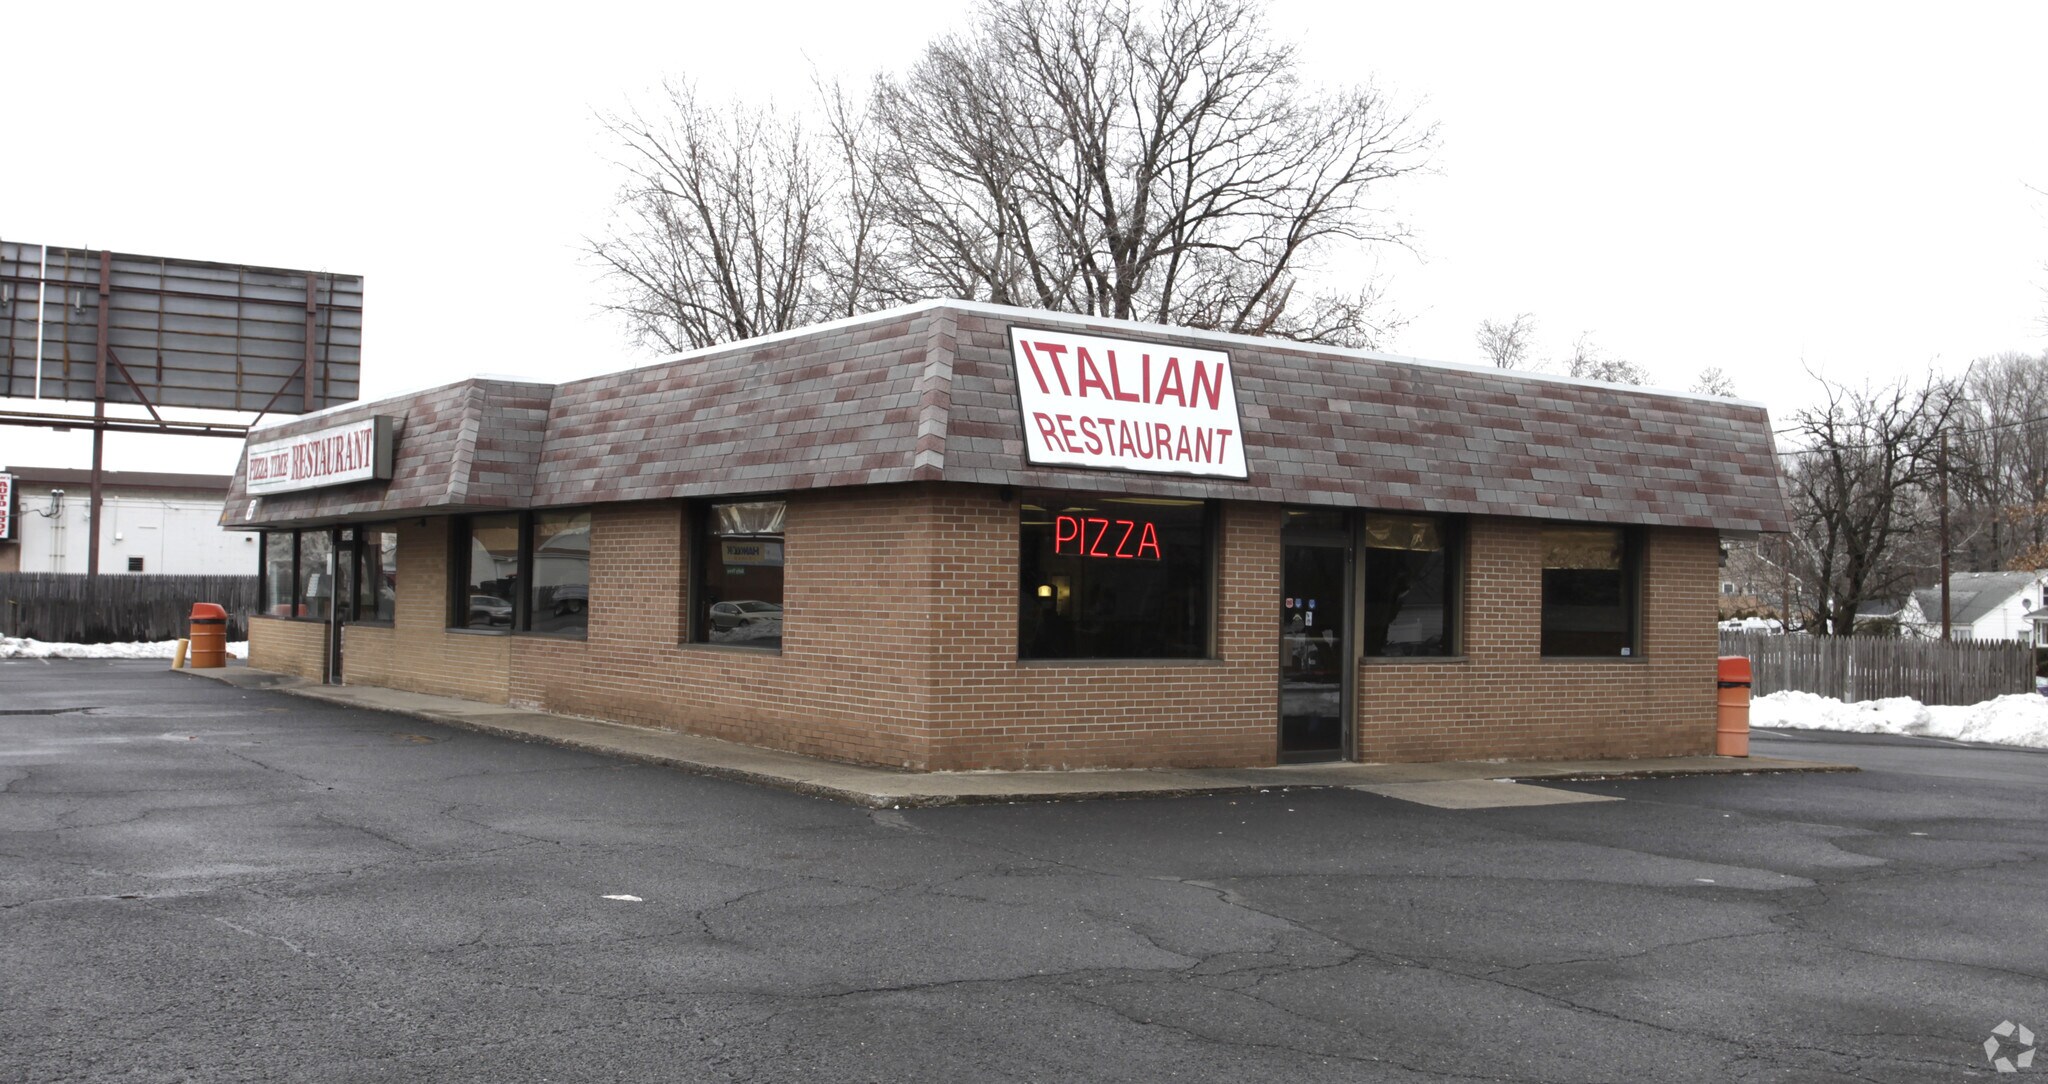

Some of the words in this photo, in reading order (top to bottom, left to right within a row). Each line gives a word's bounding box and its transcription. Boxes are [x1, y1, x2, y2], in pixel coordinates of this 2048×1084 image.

[1019, 339, 1224, 410] ITALIAN
[249, 457, 268, 481] PIZZA
[269, 452, 289, 478] TIME
[290, 428, 373, 481] RESTAURANT
[1032, 411, 1233, 465] RESTAURANT
[1055, 515, 1161, 559] PIZZA
